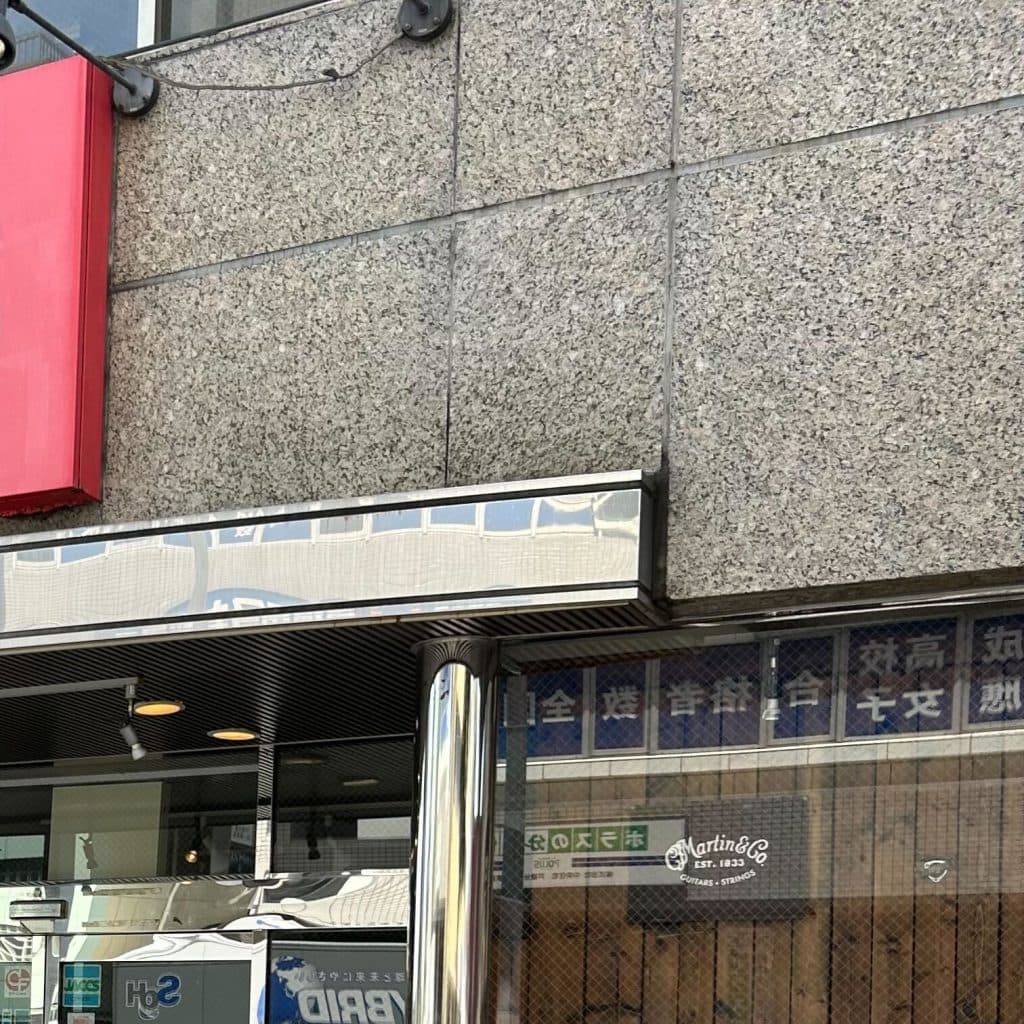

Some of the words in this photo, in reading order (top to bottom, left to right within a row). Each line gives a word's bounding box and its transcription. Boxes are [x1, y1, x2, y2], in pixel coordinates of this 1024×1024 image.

[720, 858, 745, 867] 1833
[680, 873, 714, 887] GUITARS
[721, 869, 756, 885] STRINGS
